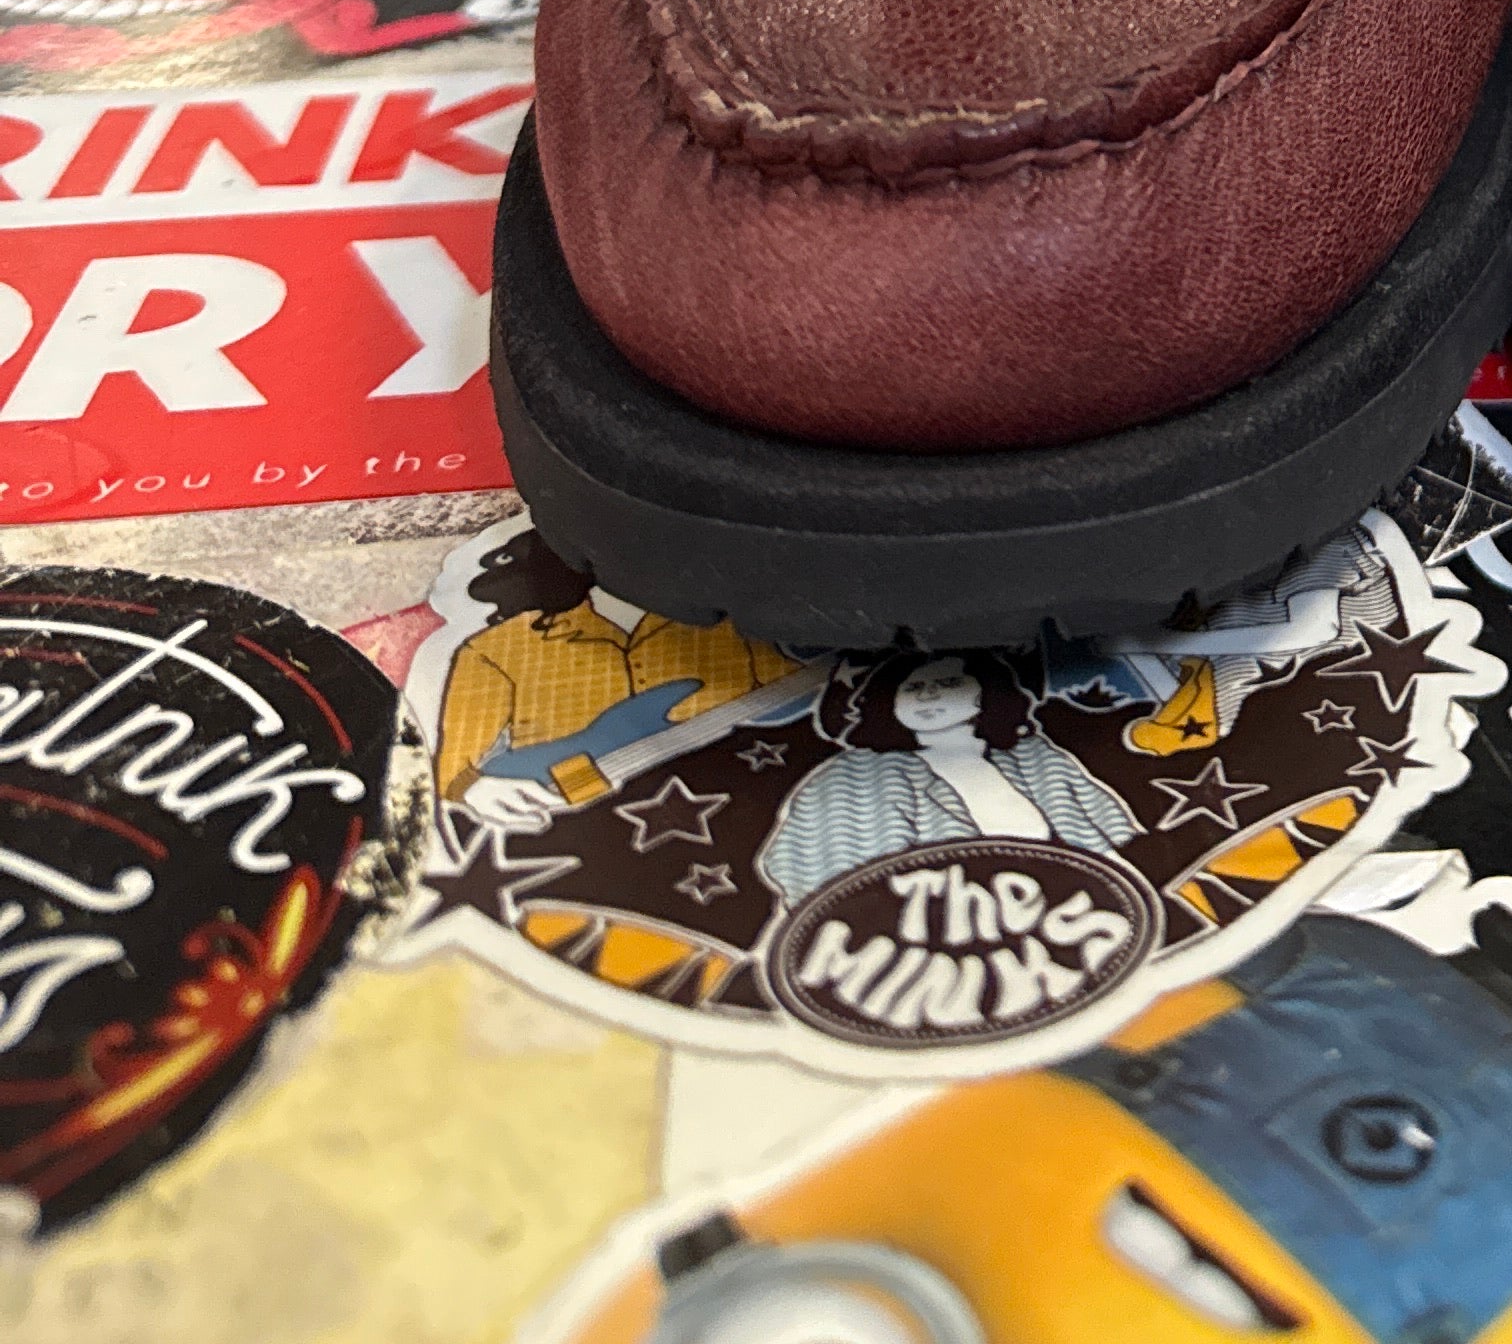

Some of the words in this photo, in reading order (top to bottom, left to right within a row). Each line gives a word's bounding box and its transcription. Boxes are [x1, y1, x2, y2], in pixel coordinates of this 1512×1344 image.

[0, 253, 286, 421] R
[89, 472, 211, 502] you
[251, 461, 328, 489] by
[365, 451, 466, 475] the
[801, 890, 1136, 1027] MINKS
[891, 865, 1044, 945] The
